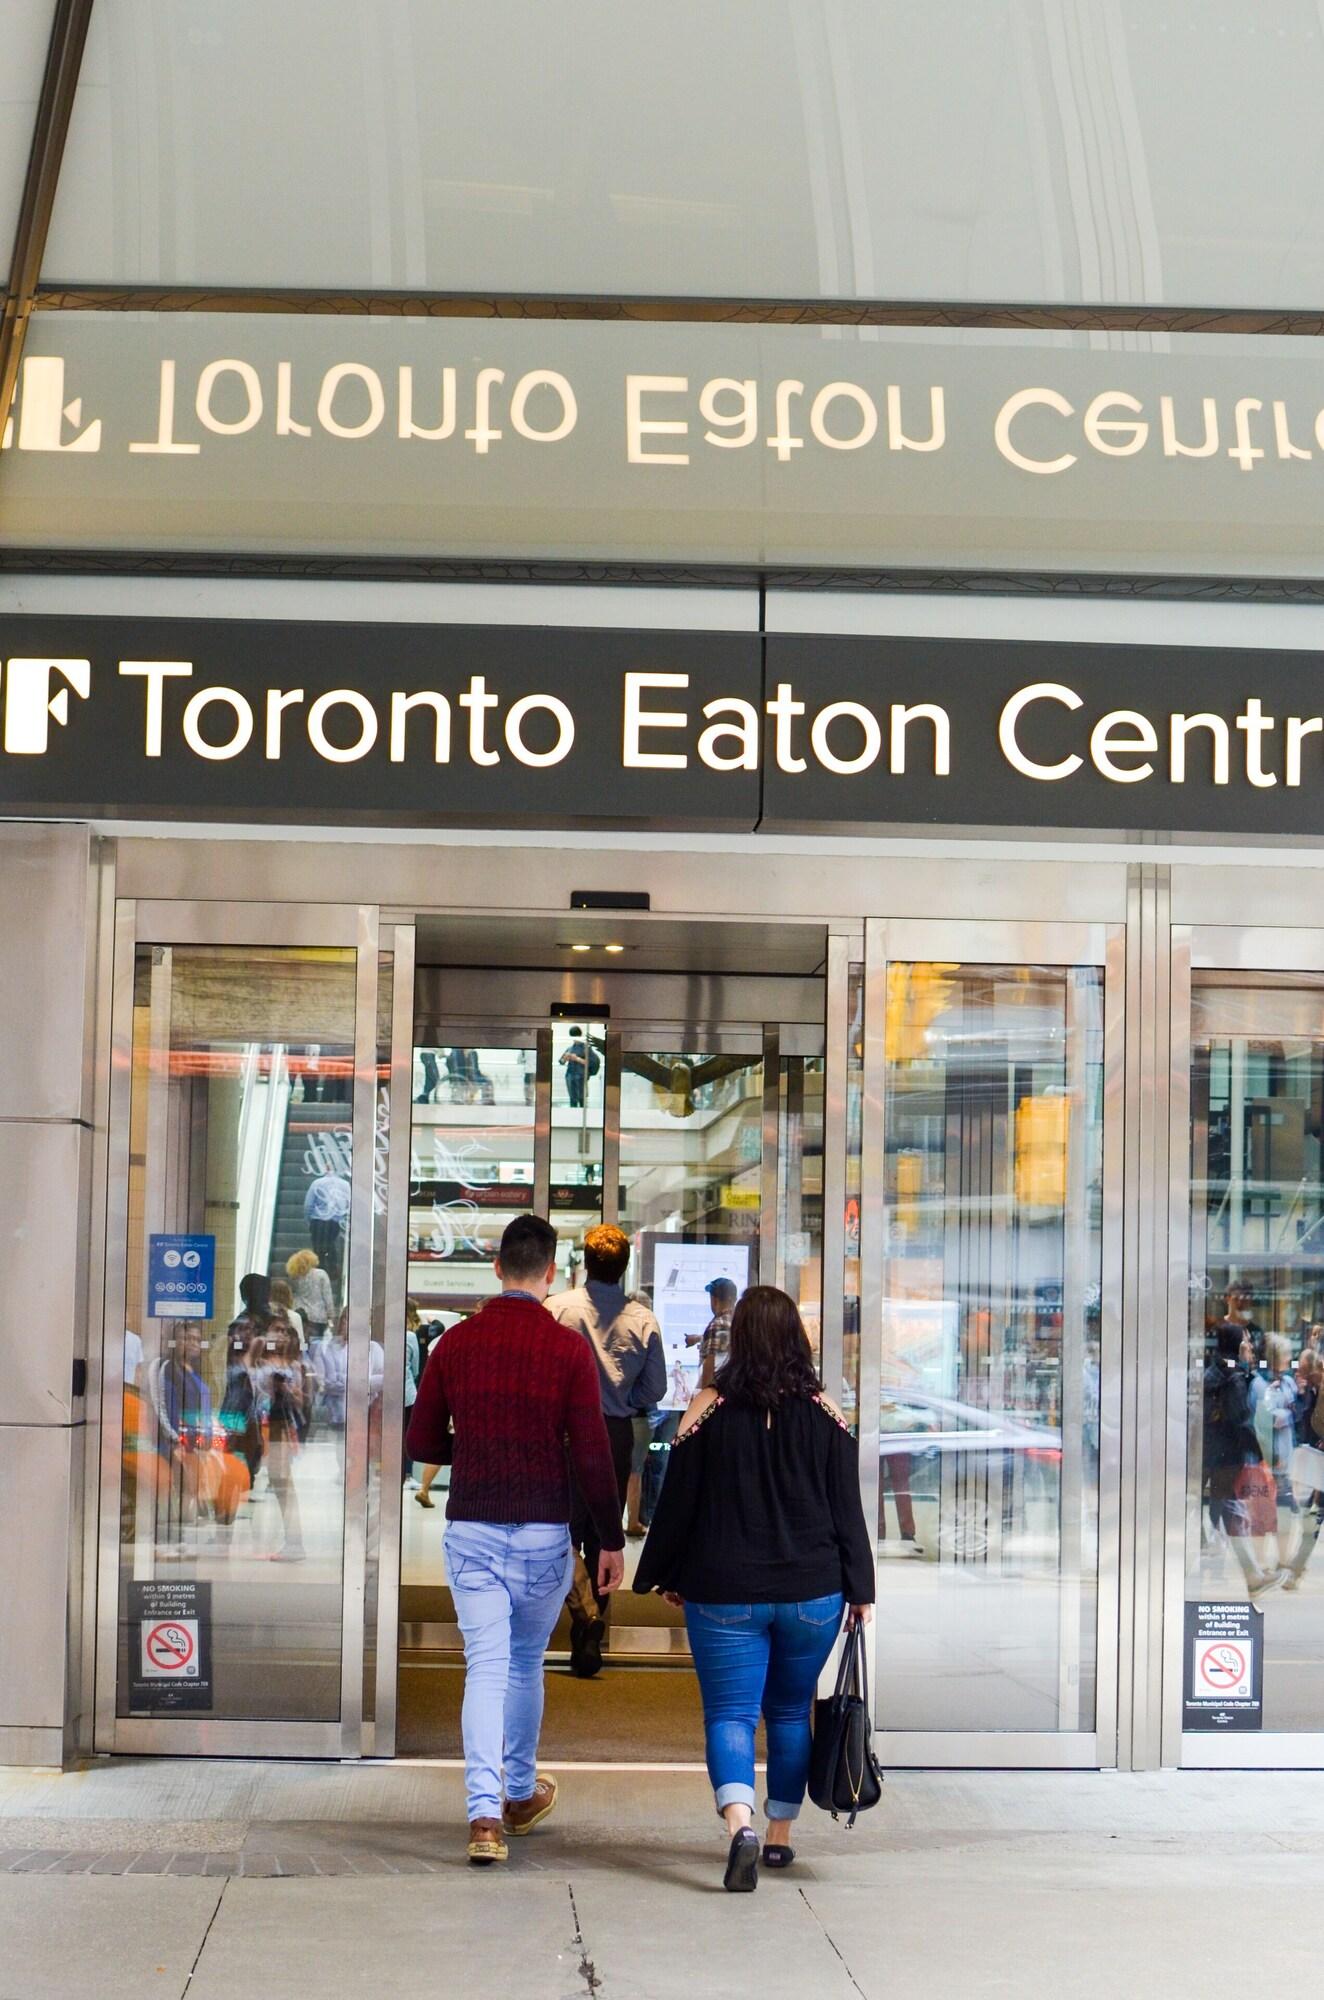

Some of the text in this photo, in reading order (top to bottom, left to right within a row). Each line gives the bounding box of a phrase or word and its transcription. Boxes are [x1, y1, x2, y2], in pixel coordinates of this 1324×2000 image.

[118, 660, 576, 768] Toronto
[622, 671, 951, 777] Eaton
[157, 1584, 196, 1592] SMOKING
[159, 1601, 186, 1609] Building
[1212, 1605, 1250, 1613] SMOKING
[1214, 1621, 1241, 1629] Building
